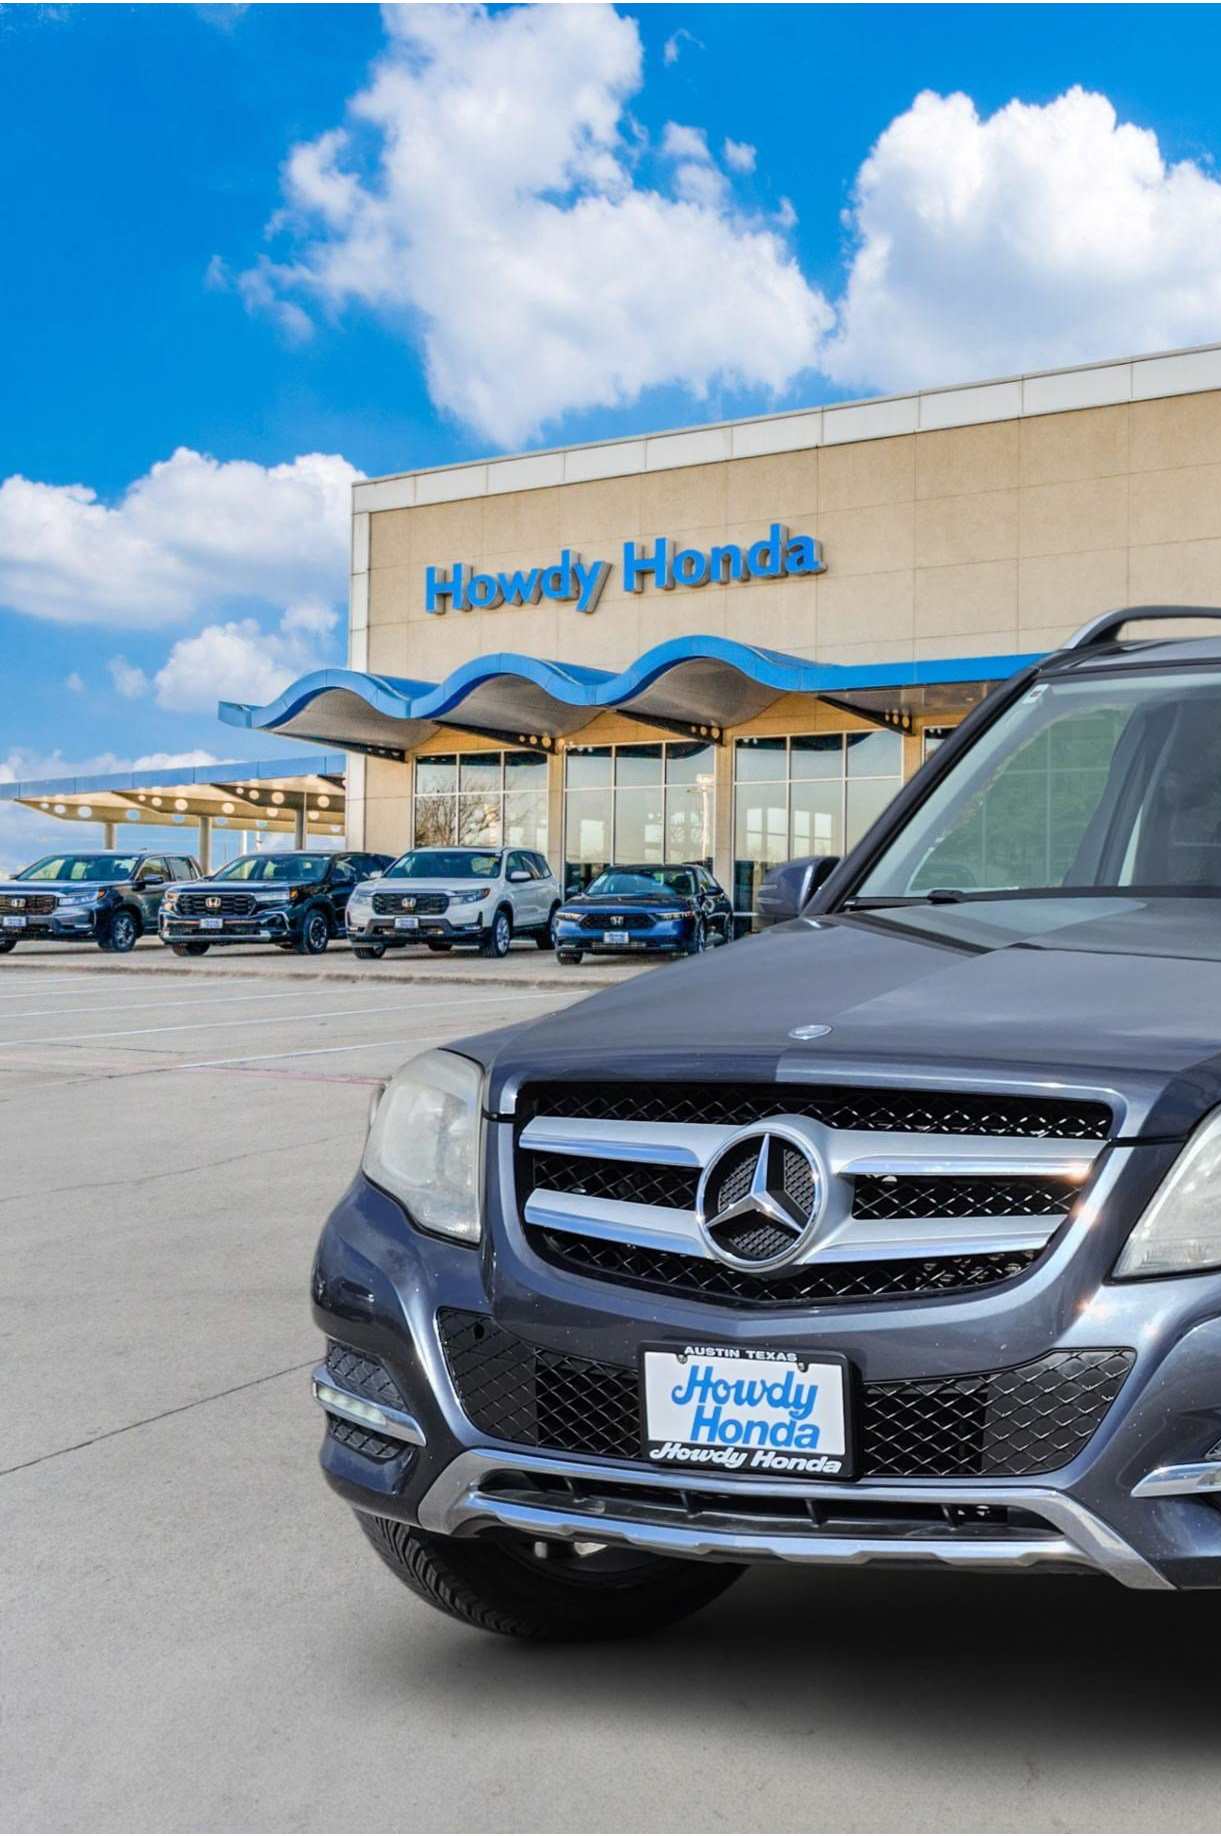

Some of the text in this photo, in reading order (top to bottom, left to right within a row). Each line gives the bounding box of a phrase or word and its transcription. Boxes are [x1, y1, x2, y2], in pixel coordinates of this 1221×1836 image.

[425, 523, 827, 614] Howdy Honda
[684, 1346, 798, 1362] AUSTIN TEXAS
[671, 1365, 818, 1420] Howdy
[690, 1405, 820, 1449] Honda
[650, 1442, 842, 1474] Howdy Honda
